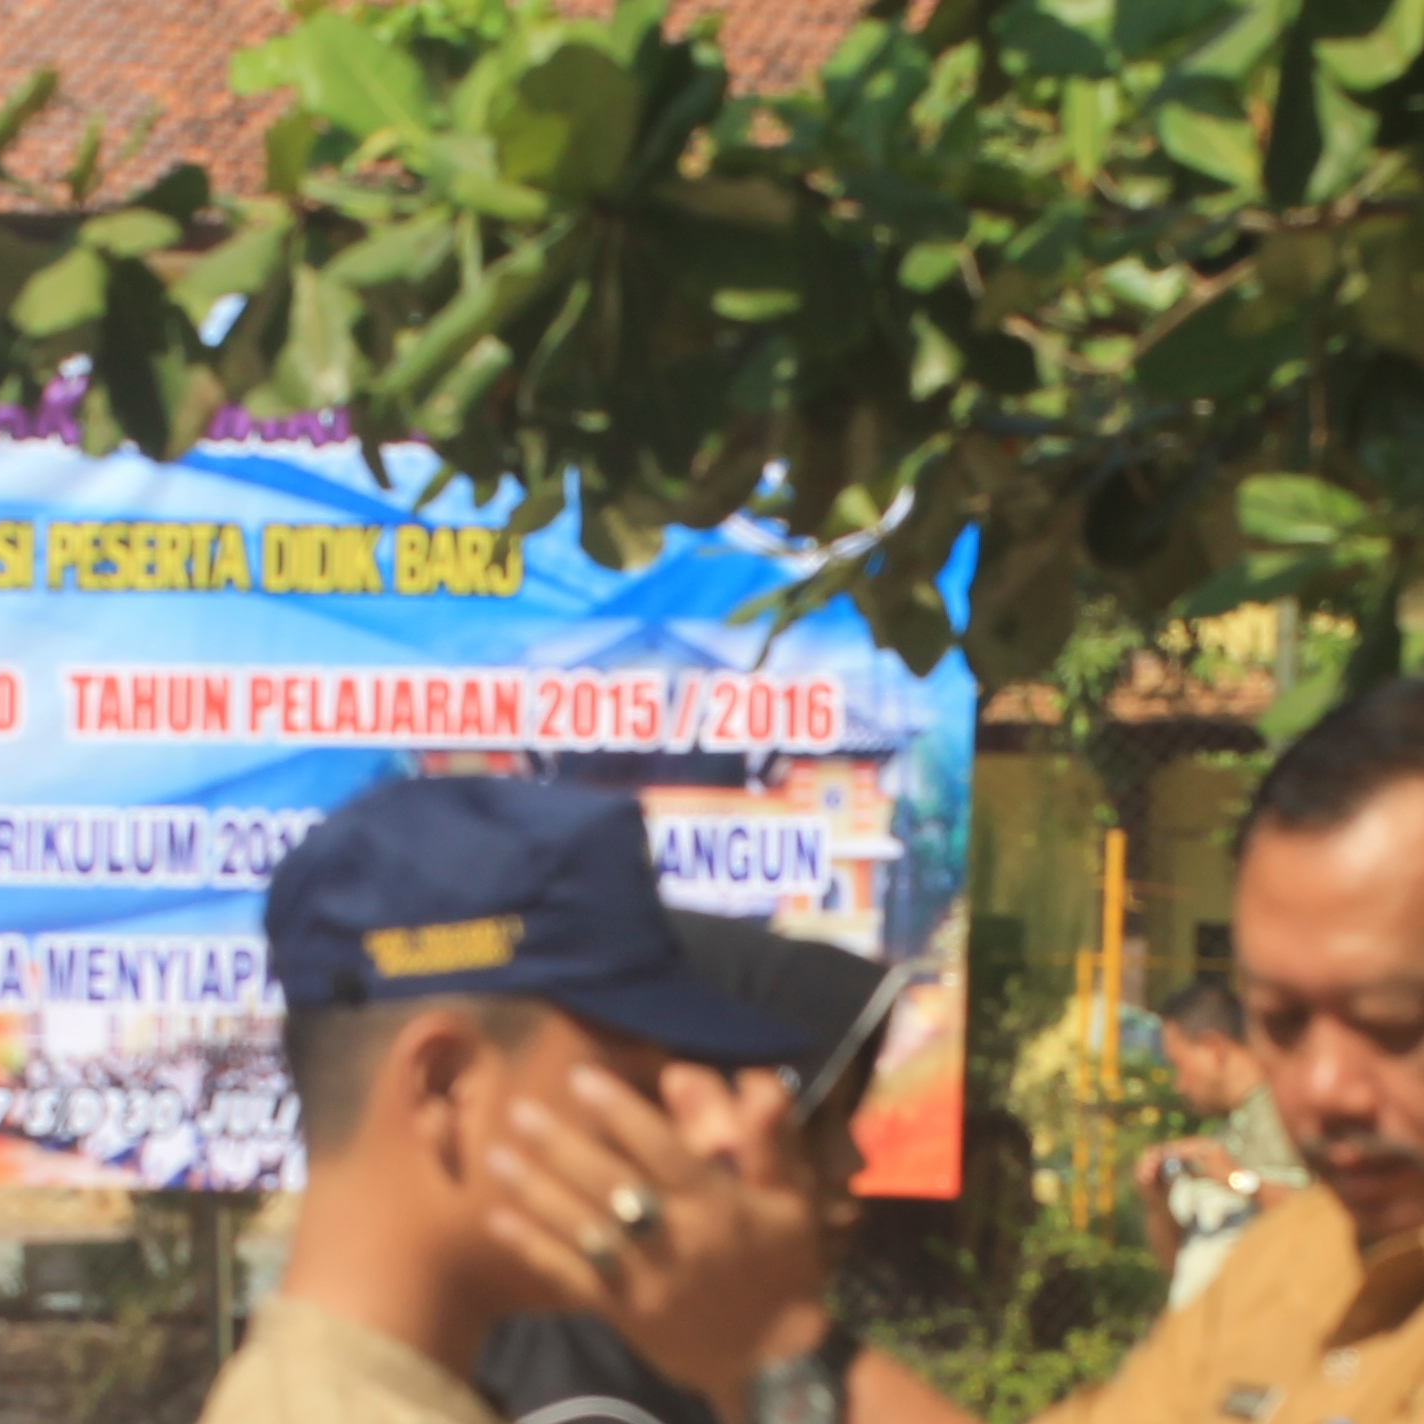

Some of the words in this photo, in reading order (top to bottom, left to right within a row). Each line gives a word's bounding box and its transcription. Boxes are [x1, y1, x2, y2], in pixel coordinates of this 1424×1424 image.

[46, 520, 252, 592] PESERTA
[261, 523, 384, 594] DIDIK
[71, 674, 229, 733] TAHUN
[250, 676, 520, 736] PELAJARAN
[658, 827, 821, 882] ANGUN
[46, 948, 270, 1002] MENYIAP
